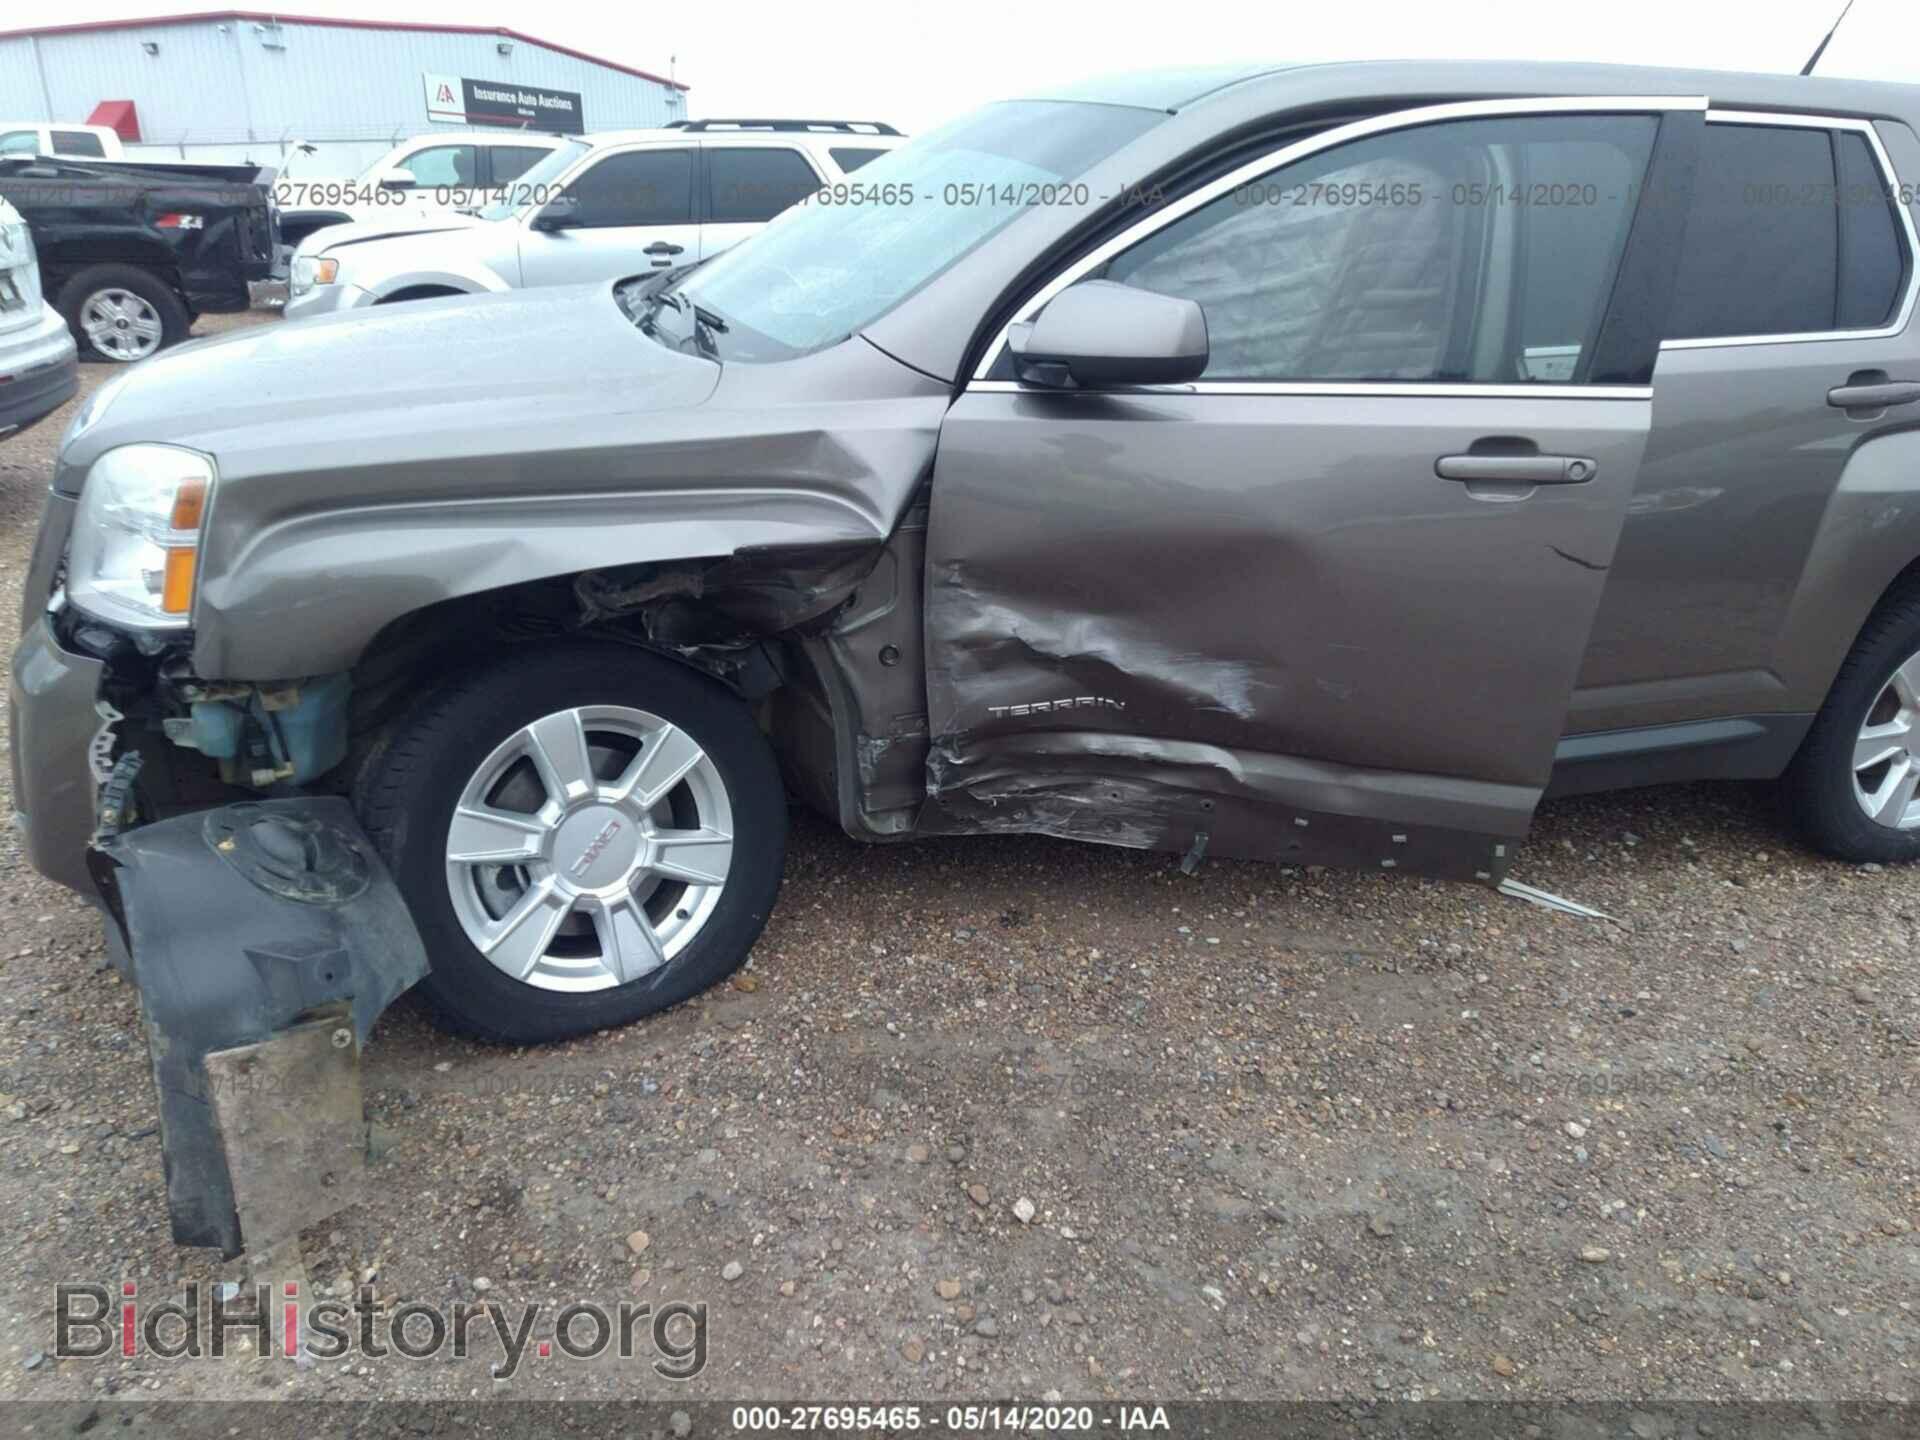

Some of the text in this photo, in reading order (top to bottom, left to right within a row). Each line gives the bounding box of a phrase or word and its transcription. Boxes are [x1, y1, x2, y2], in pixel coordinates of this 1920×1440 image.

[473, 85, 517, 105] Insurance
[518, 91, 537, 107] Auto
[538, 94, 574, 112] Auctions
[988, 696, 1124, 718] TERRAIN
